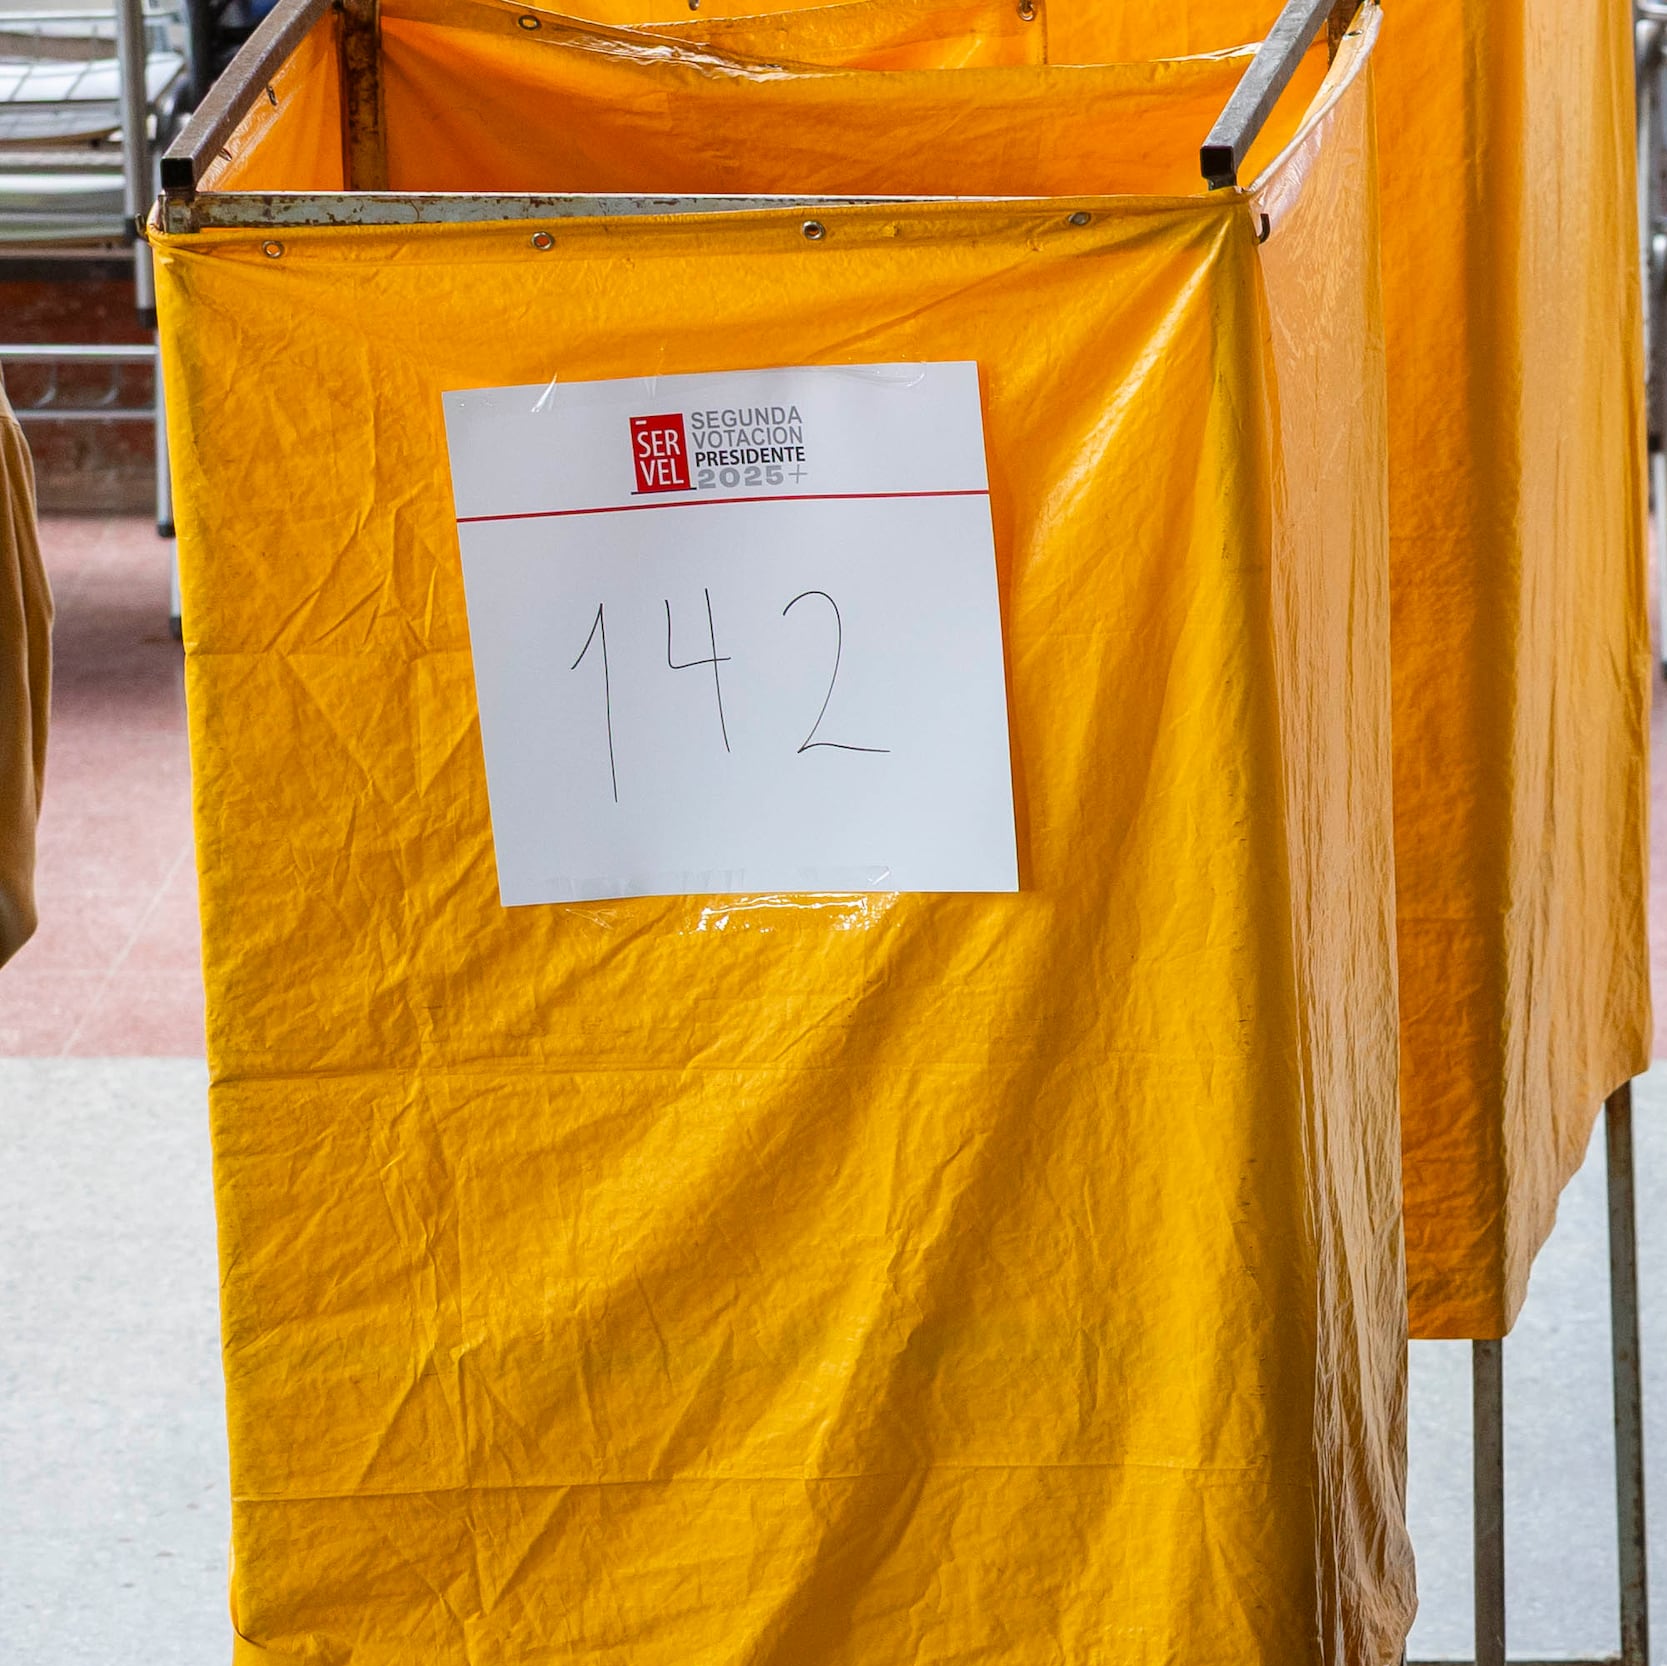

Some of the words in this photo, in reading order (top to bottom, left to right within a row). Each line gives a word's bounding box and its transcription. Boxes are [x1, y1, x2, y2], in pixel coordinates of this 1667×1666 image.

[690, 405, 802, 430] SEGUNDA
[637, 429, 681, 458] SER
[692, 425, 803, 450] VOTACION
[695, 446, 806, 468] PRESIDENTE
[639, 458, 685, 487] VEL
[570, 587, 891, 803] 142
